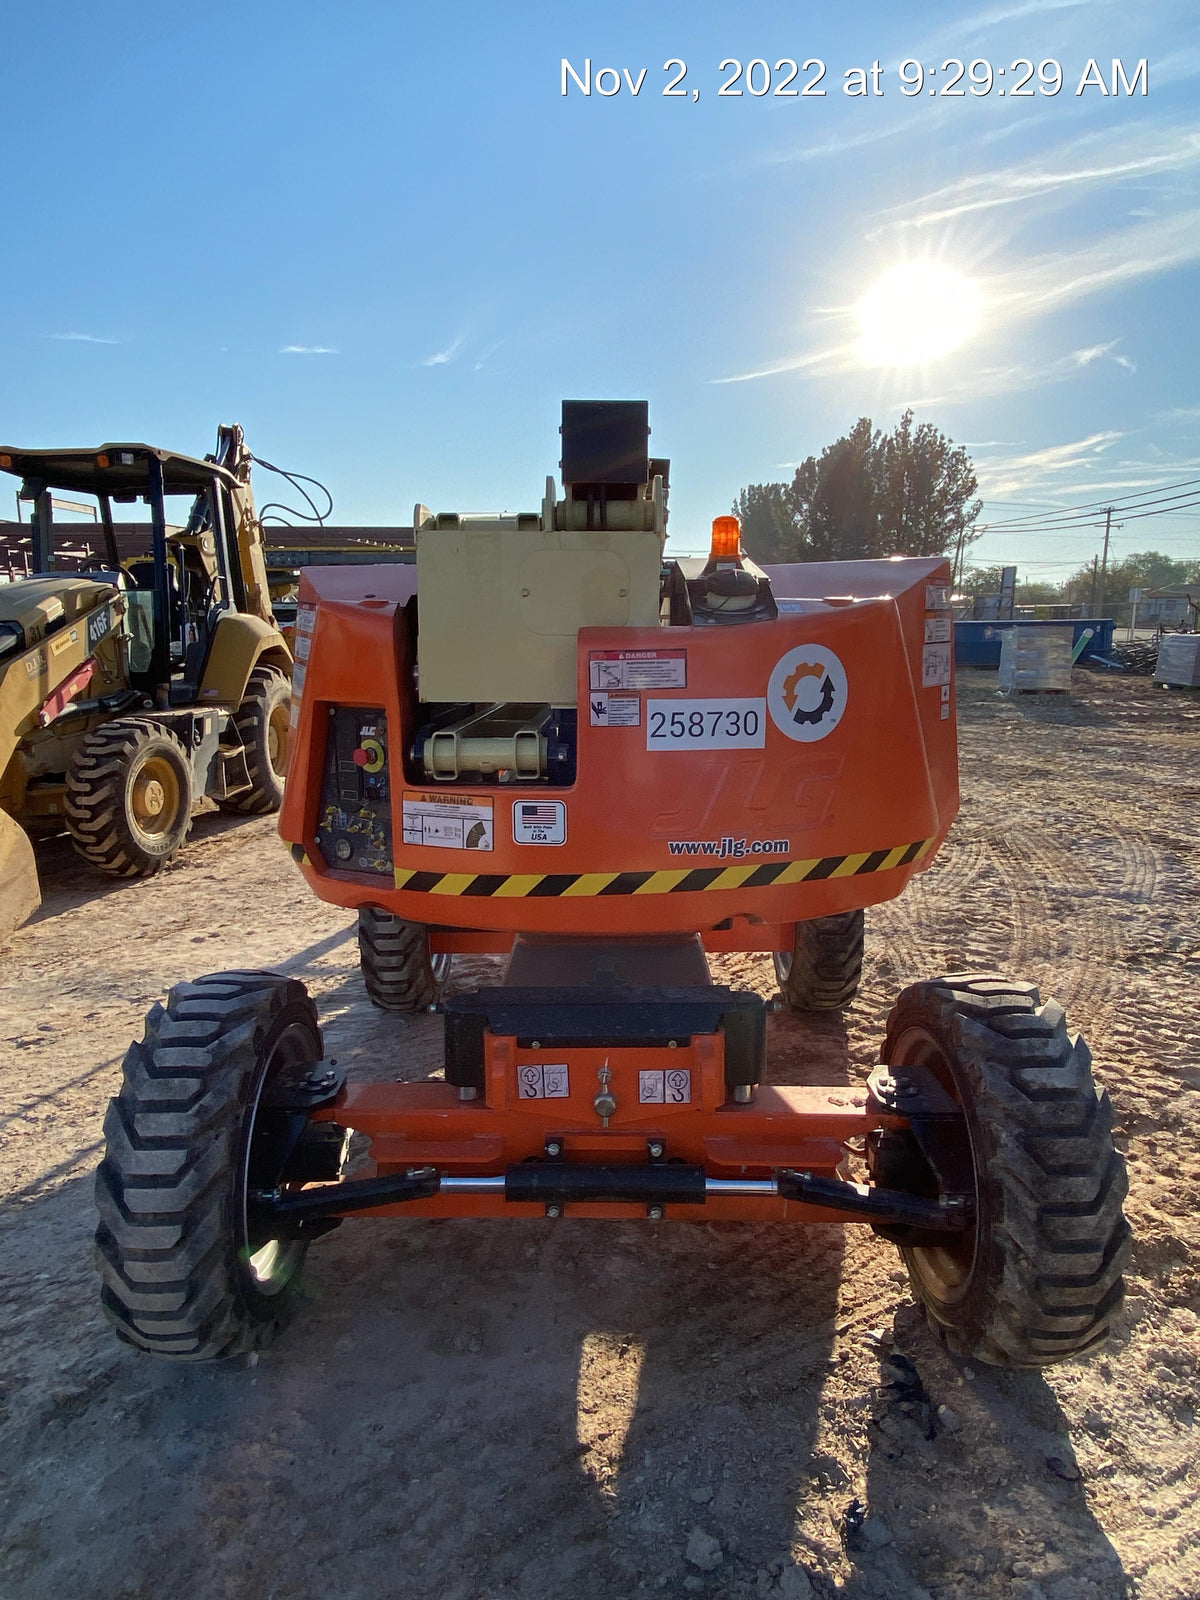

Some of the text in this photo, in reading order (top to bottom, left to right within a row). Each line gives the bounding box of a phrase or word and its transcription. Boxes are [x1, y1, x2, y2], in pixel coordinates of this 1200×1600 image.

[90, 611, 107, 641] 416F
[650, 711, 759, 738] 258730
[429, 795, 474, 806] WARNING
[650, 752, 847, 840] JLG
[669, 838, 789, 858] www.jlg.com
